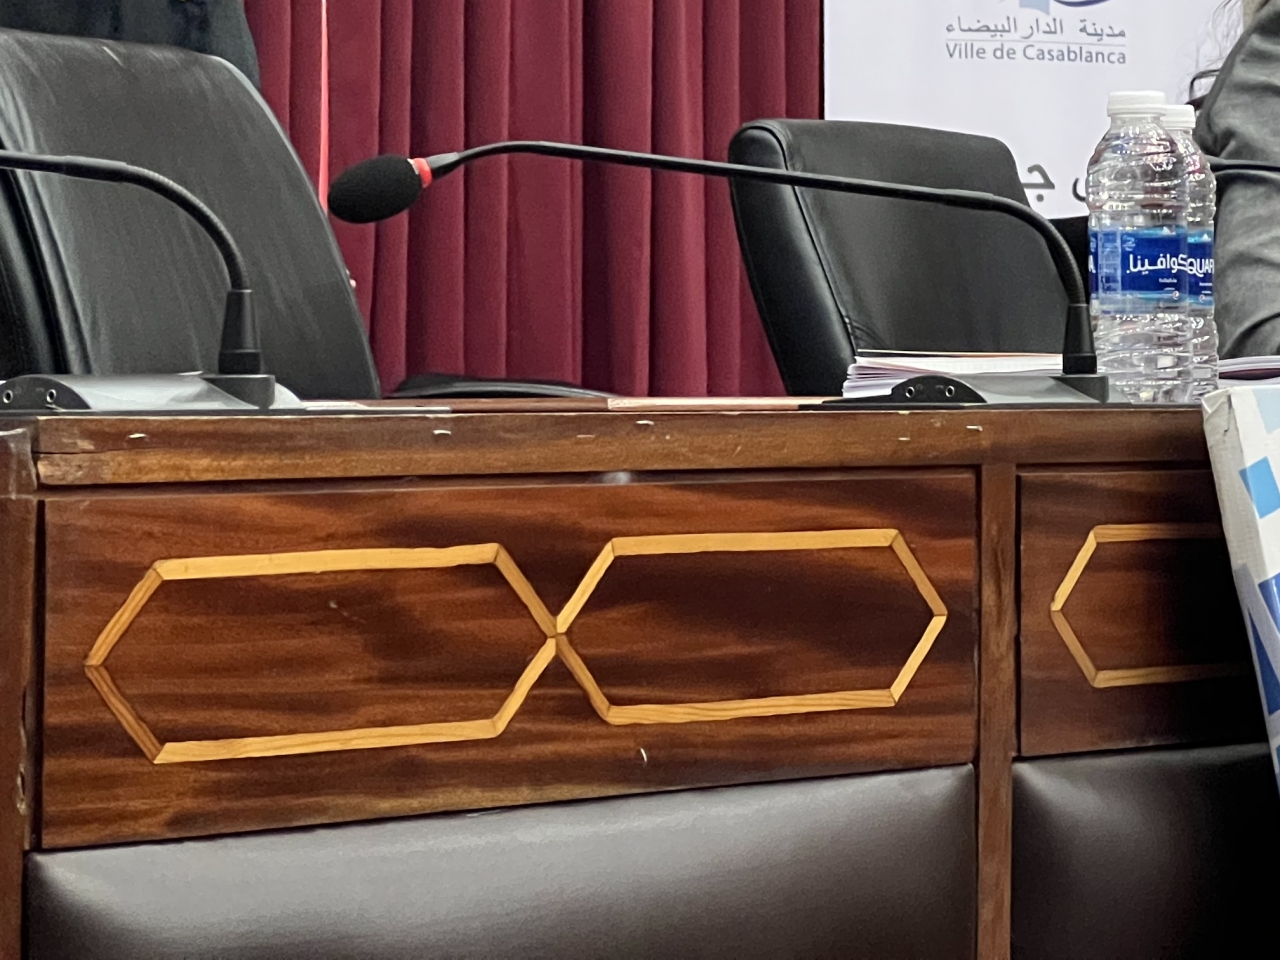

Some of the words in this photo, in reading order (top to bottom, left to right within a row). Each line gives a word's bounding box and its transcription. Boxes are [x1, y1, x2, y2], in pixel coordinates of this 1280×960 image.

[946, 15, 1017, 38] البيضاء
[1021, 17, 1063, 39] الدار
[1079, 18, 1126, 41] مدينة
[946, 42, 986, 60] Ville
[993, 43, 1016, 60] de
[1023, 44, 1126, 64] Casablanca
